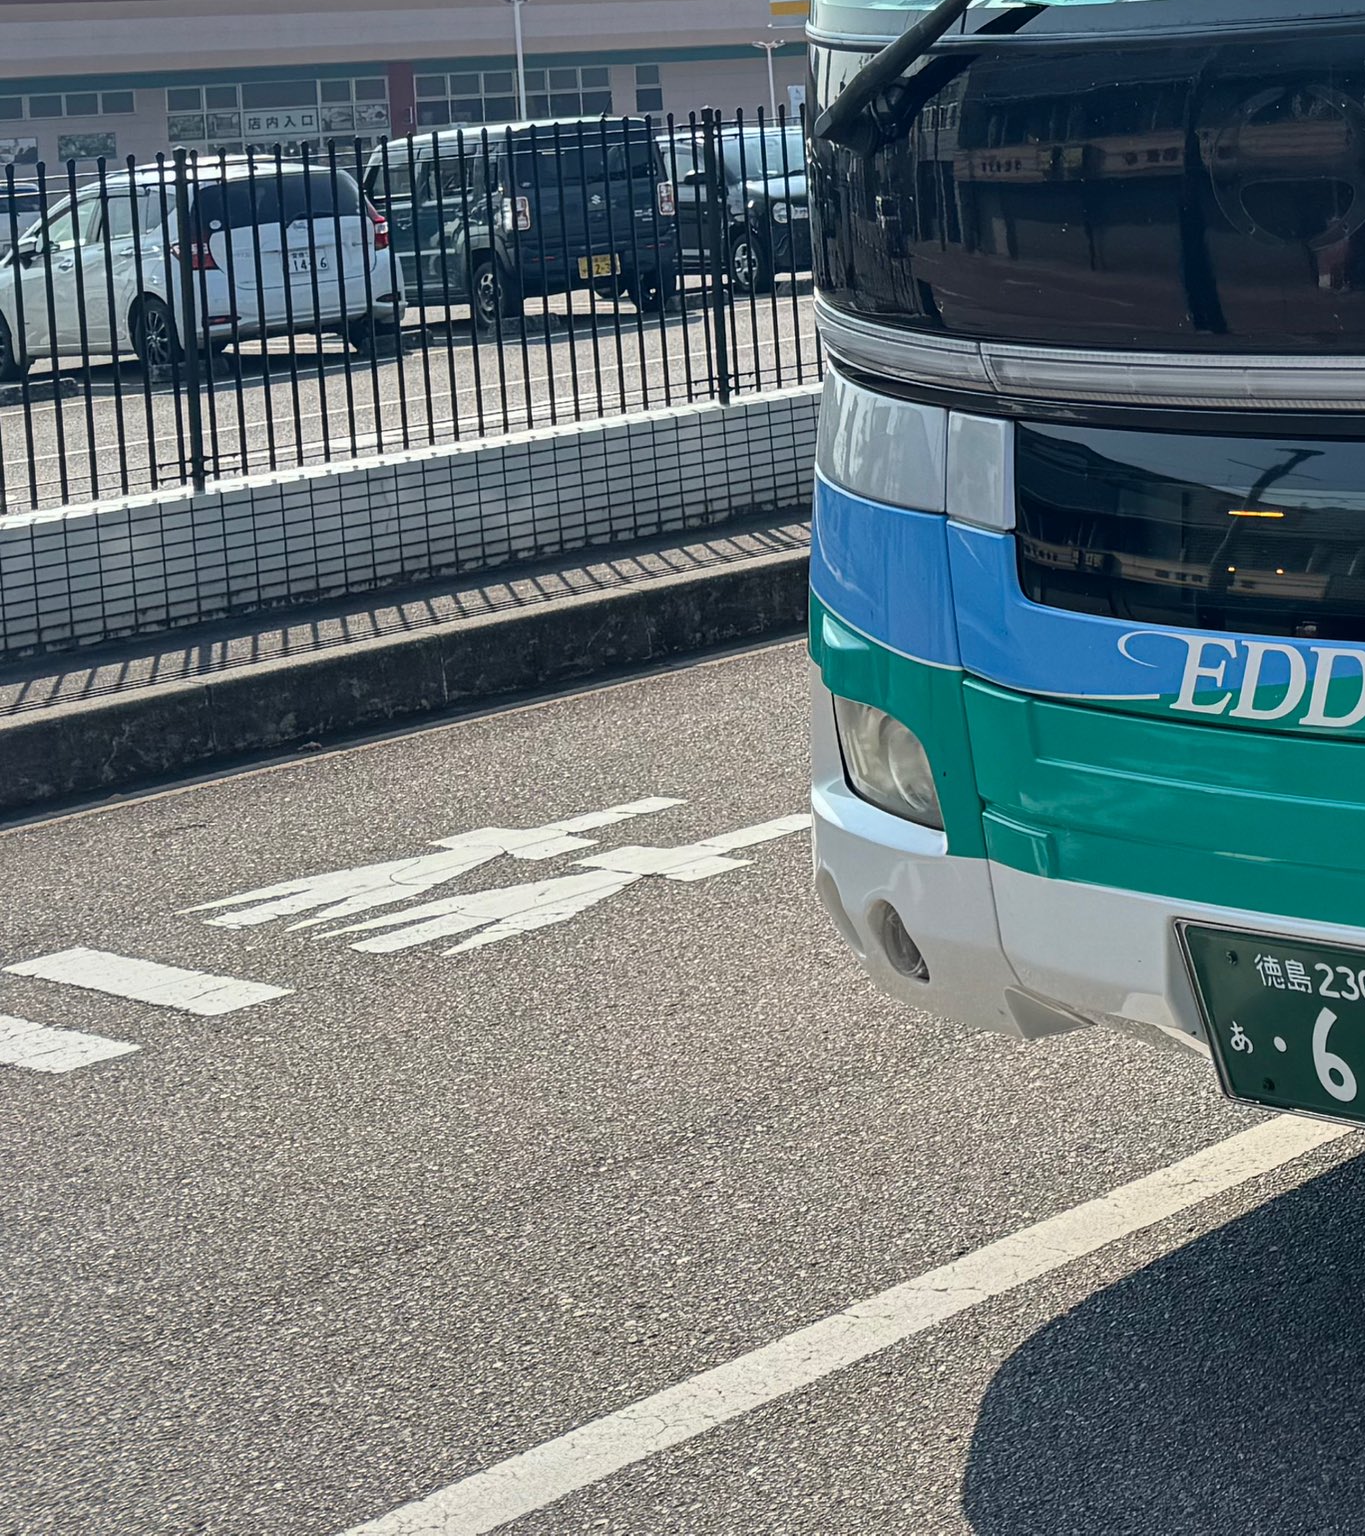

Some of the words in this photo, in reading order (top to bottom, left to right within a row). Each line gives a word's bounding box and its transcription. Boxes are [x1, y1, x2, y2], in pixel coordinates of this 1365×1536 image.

[248, 115, 314, 130] 店内入口
[1230, 1020, 1253, 1054] あ
